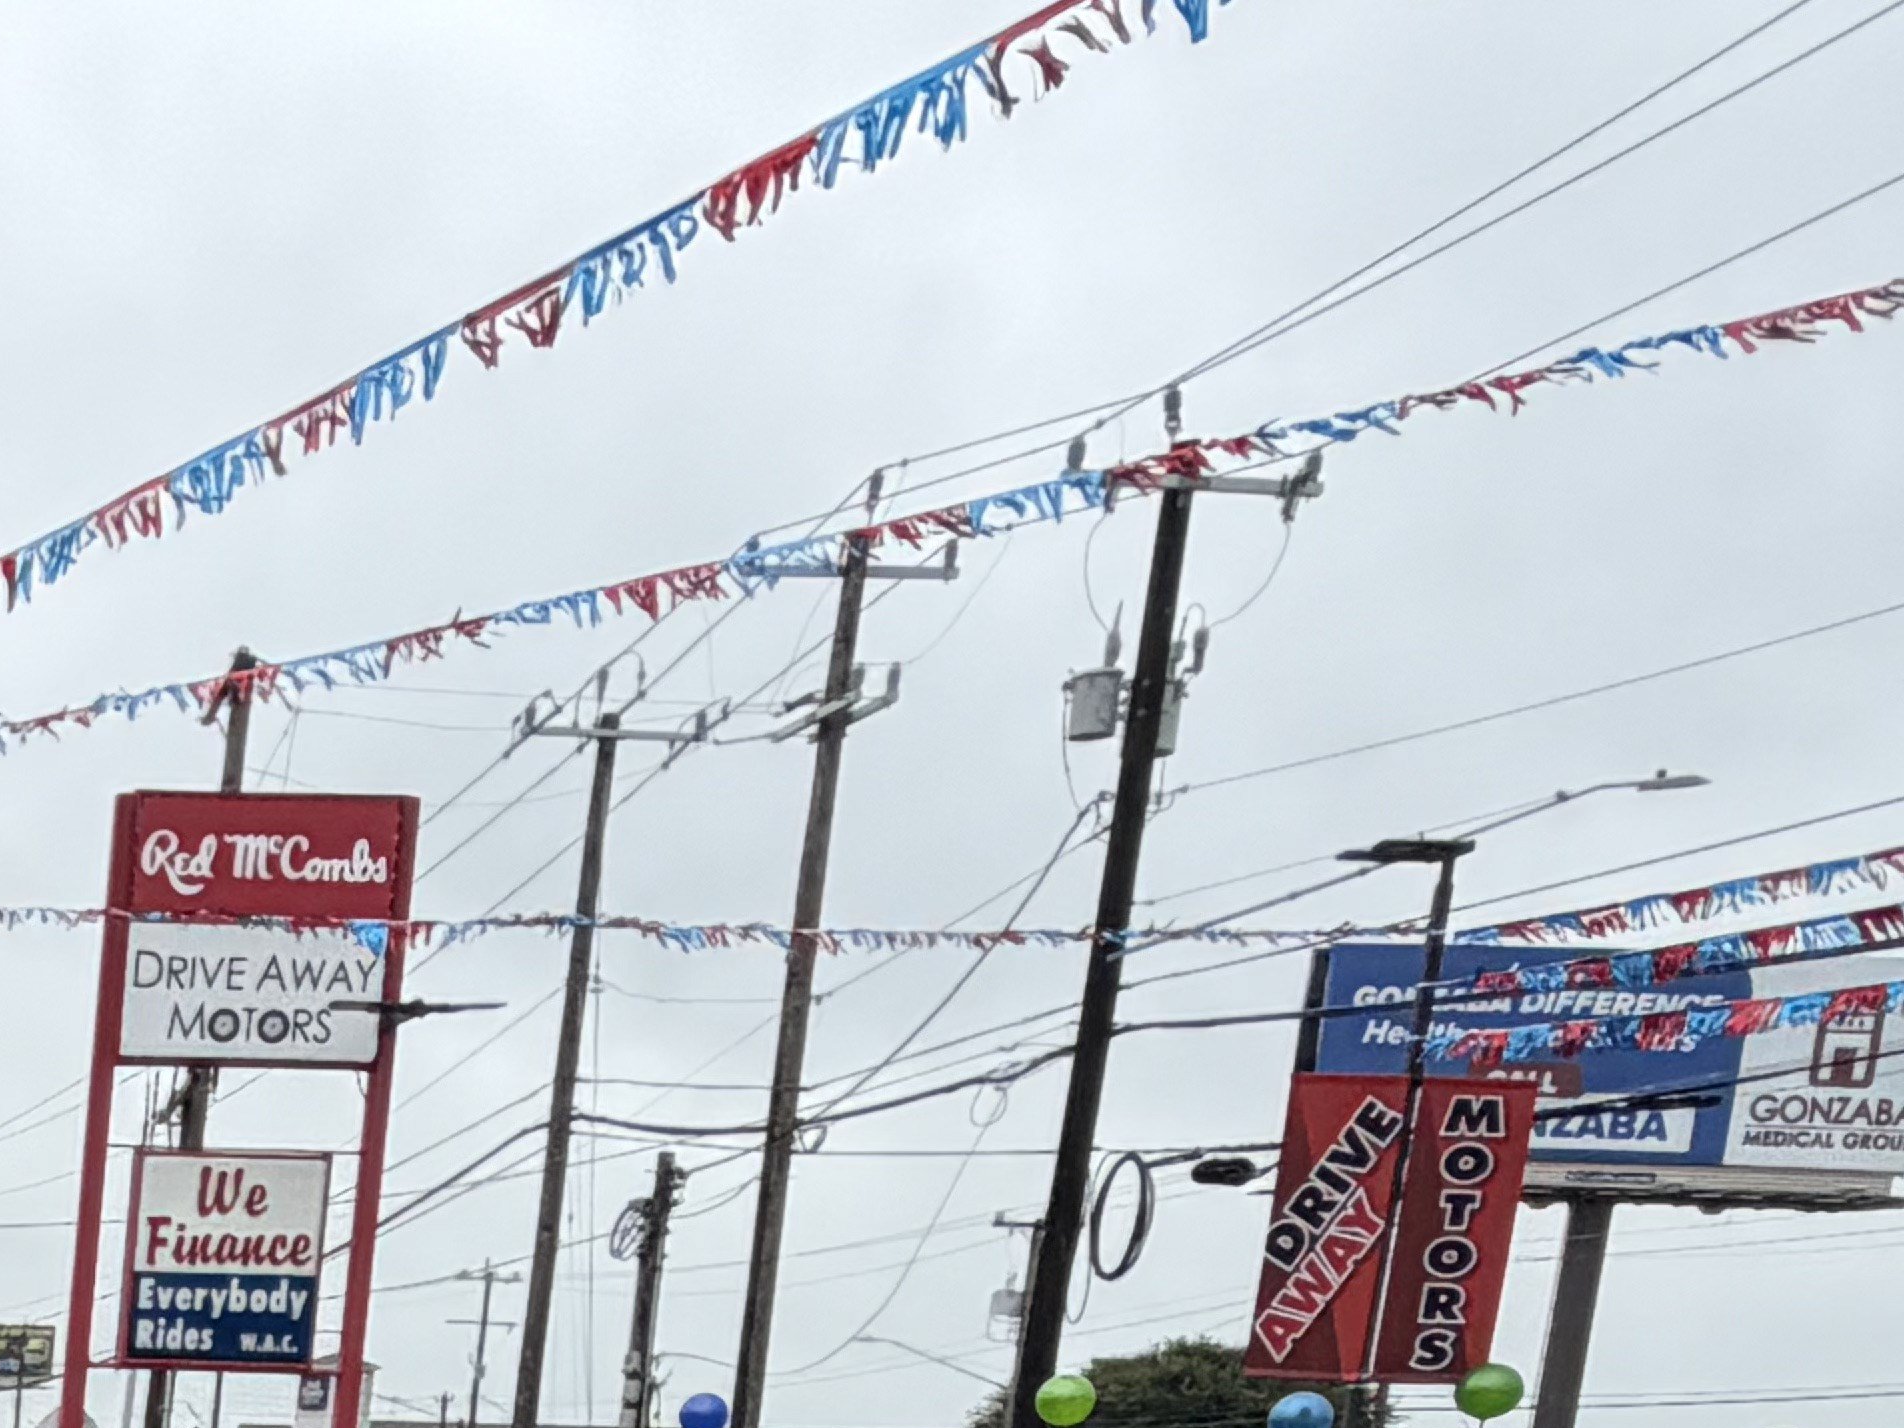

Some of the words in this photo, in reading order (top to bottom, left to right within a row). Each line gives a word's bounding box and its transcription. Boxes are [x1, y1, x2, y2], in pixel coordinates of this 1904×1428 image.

[140, 828, 218, 895] Red
[223, 833, 388, 884] McCombs
[132, 950, 249, 990] DRIVE
[256, 953, 378, 993] AWAY
[166, 1000, 332, 1044] MOTORS
[1742, 1129, 1835, 1150] MEDICAL
[1842, 1131, 1904, 1151] GROU
[197, 1165, 269, 1218] We
[1264, 1094, 1404, 1272] DRIVE
[146, 1216, 313, 1267] Finance
[1409, 1094, 1506, 1371] MOTORS
[136, 1276, 309, 1321] Everybody
[1254, 1186, 1386, 1364] AWAY
[134, 1316, 214, 1351] Rides
